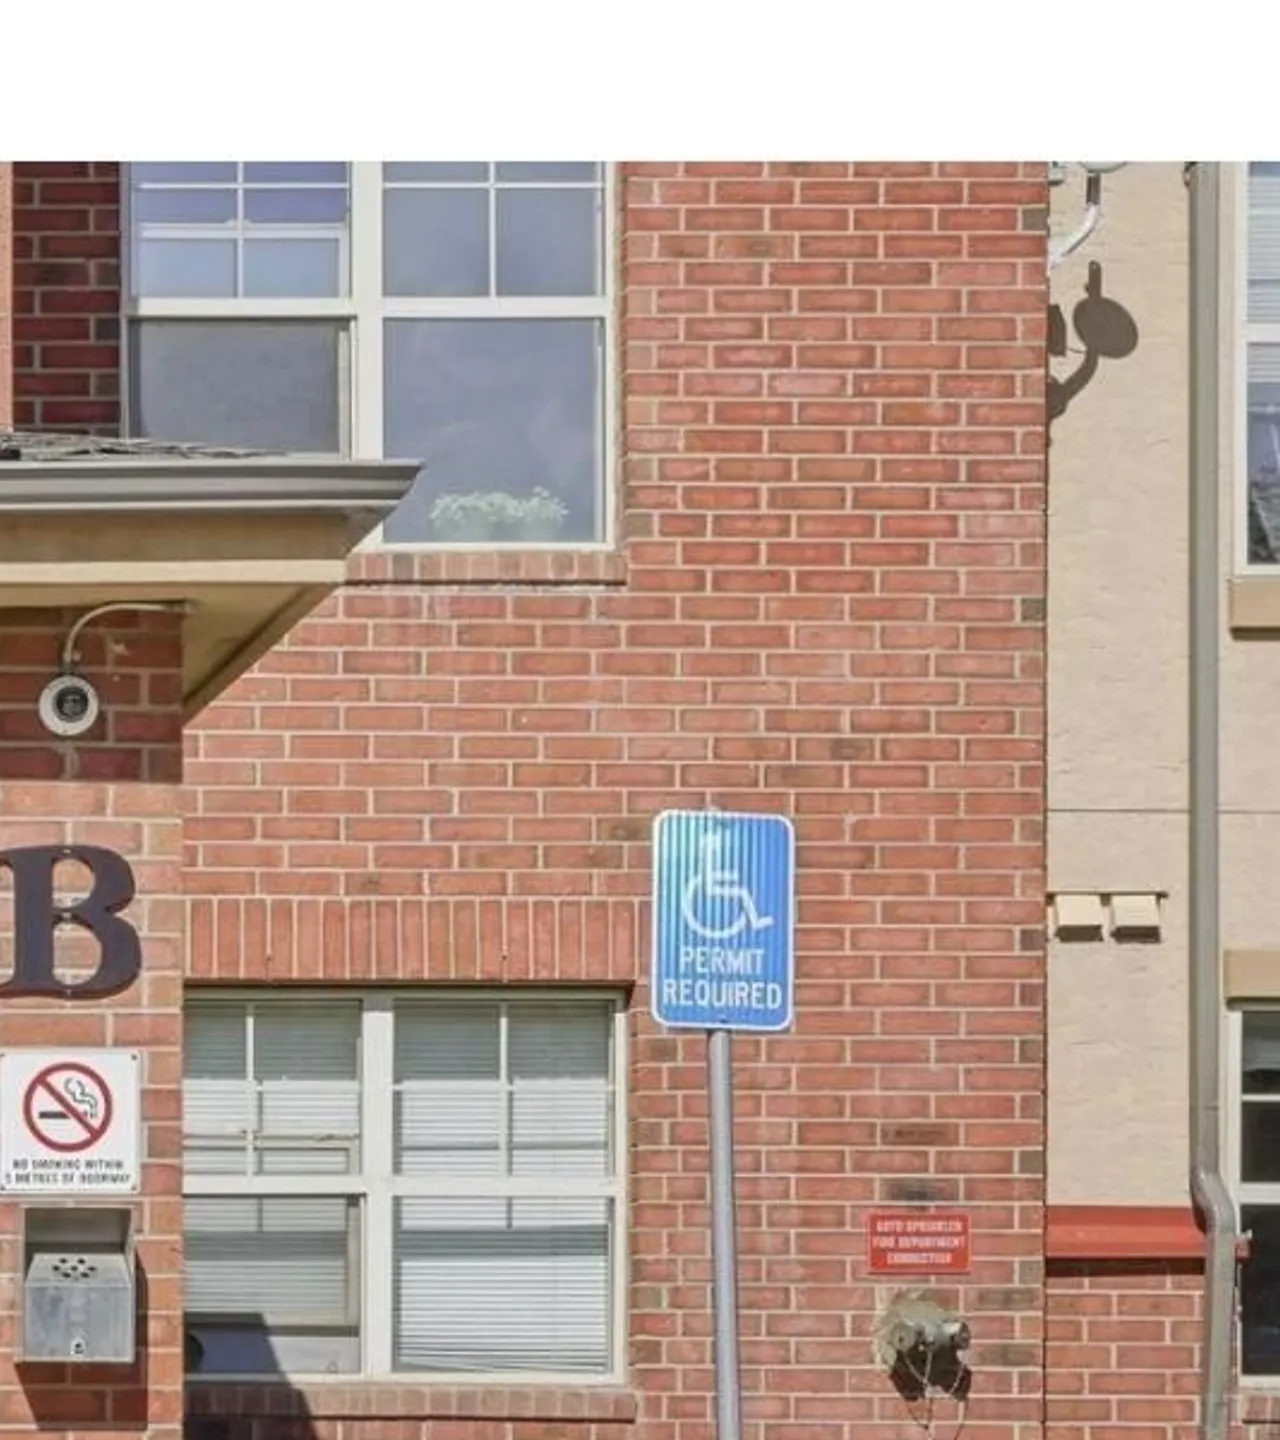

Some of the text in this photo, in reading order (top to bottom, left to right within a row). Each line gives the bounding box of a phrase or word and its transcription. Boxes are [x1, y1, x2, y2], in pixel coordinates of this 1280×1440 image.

[679, 947, 765, 976] PERMIT
[662, 979, 782, 1010] REQUIRED
[12, 1159, 123, 1170] NO SMOKING WITHIN
